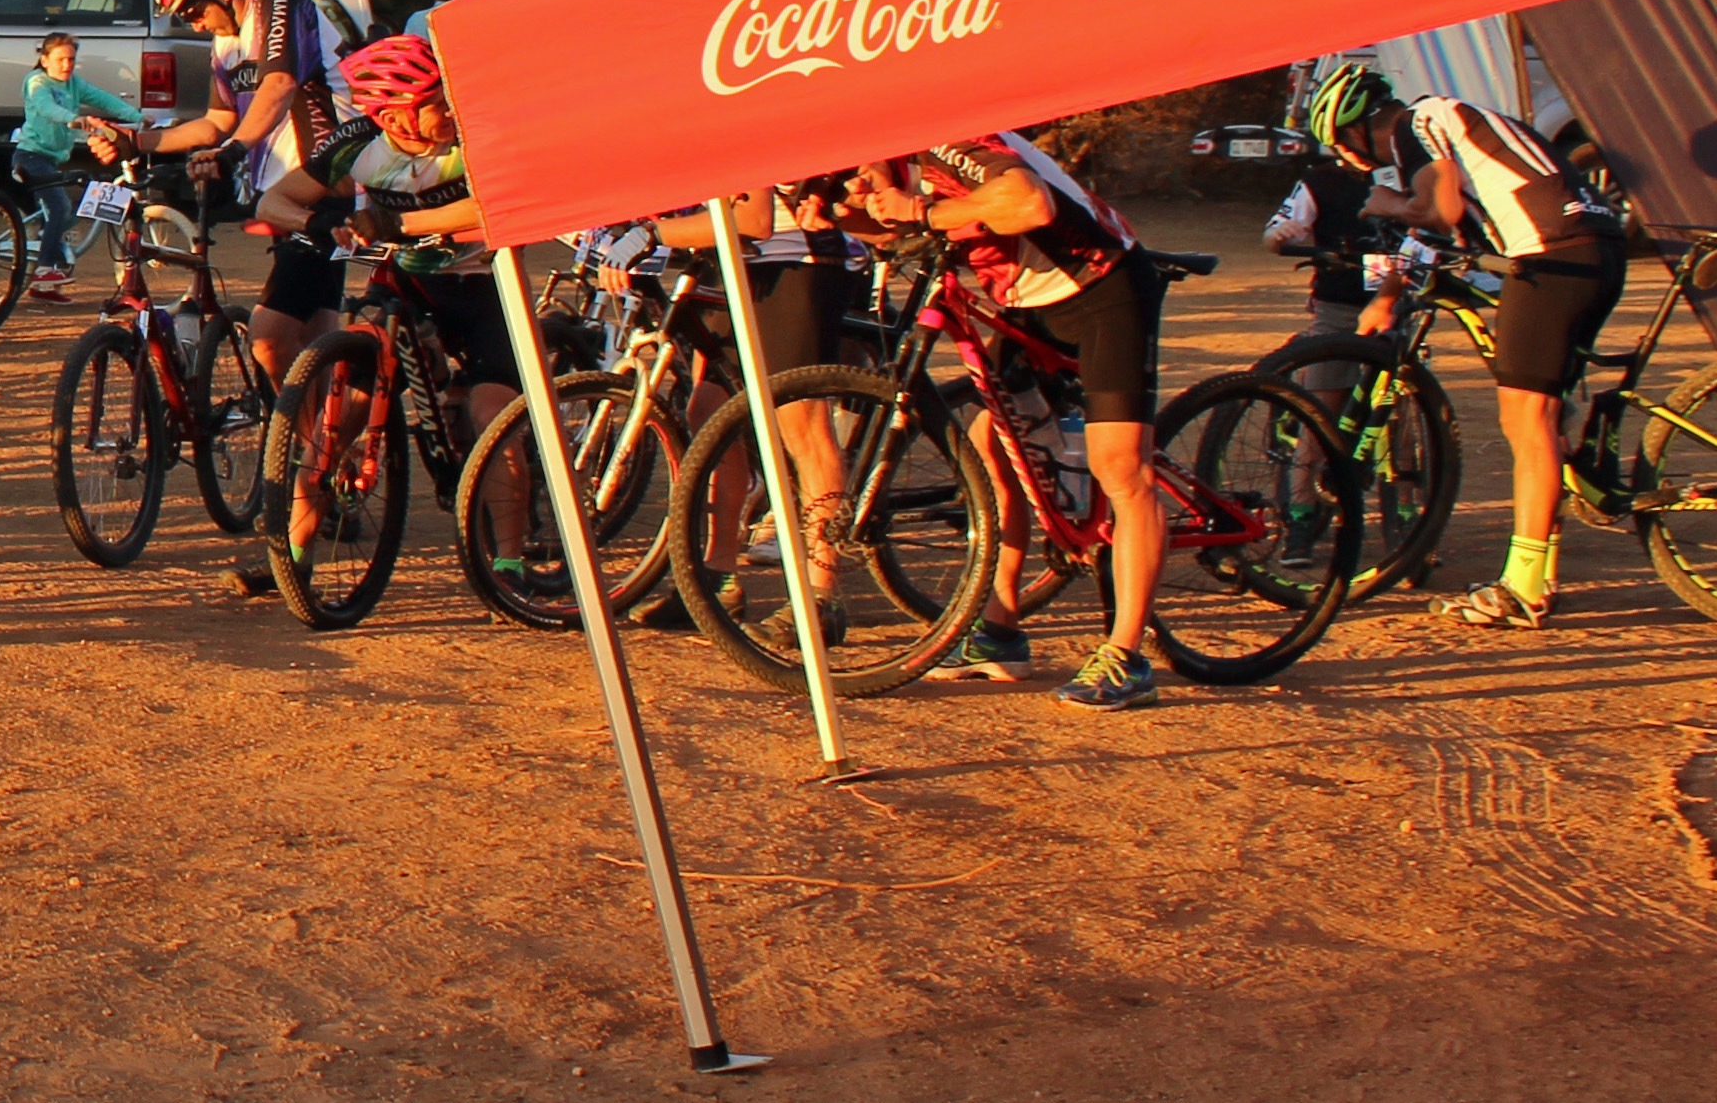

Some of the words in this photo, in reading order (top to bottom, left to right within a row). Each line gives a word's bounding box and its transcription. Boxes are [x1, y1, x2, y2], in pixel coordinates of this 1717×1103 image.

[311, 120, 370, 159] NAMAQUA
[930, 143, 988, 184] MAQUA
[98, 184, 116, 202] 53
